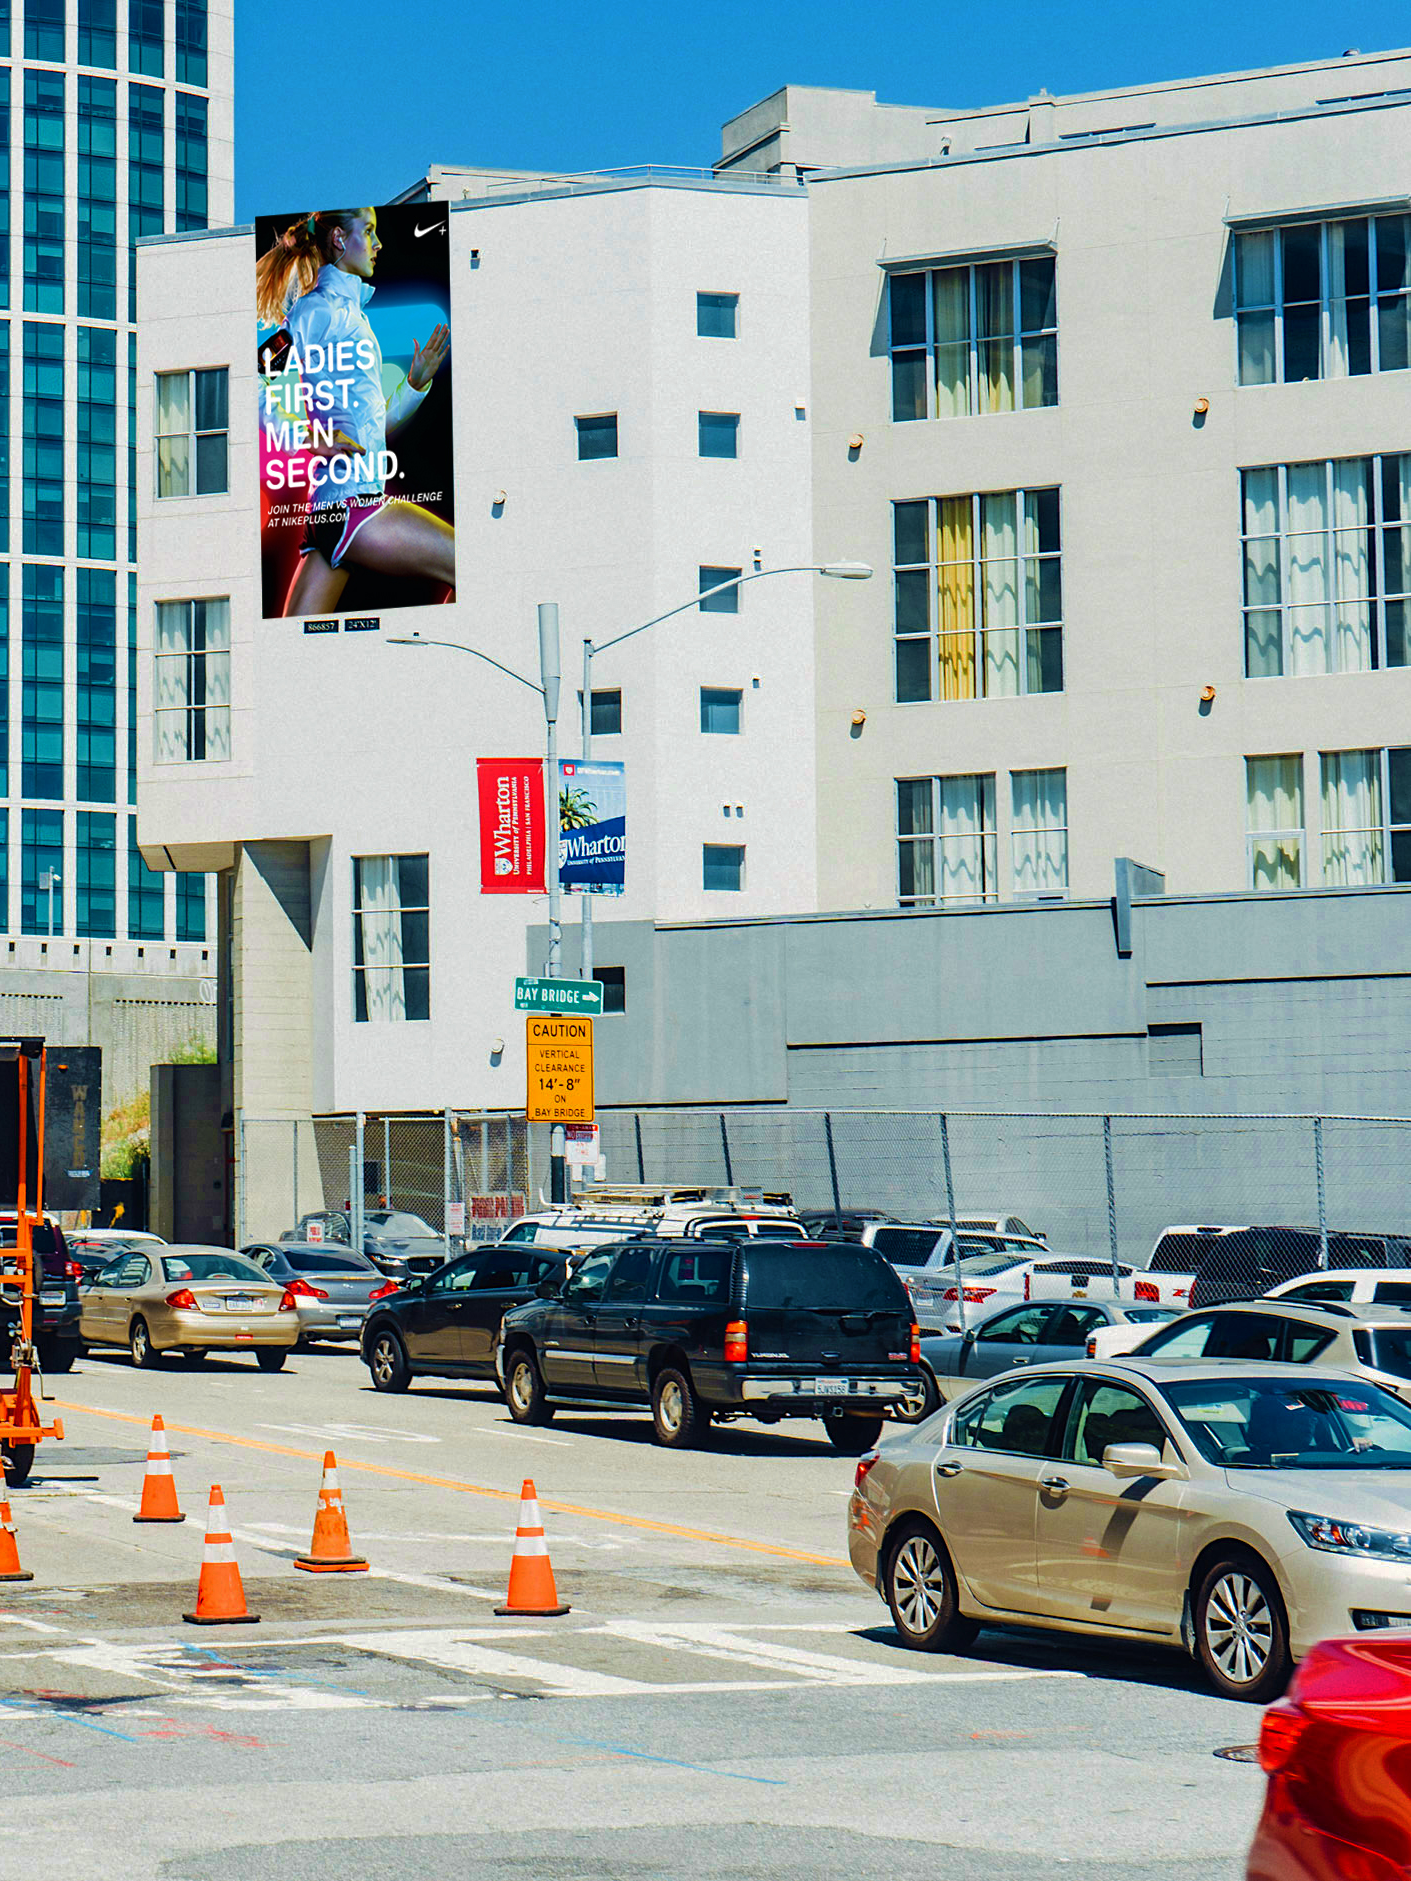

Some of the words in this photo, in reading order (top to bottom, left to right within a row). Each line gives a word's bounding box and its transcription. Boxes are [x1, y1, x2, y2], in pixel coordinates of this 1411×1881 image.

[264, 339, 375, 379] LADIES
[264, 378, 359, 416] FIRST.
[265, 417, 334, 453] MEN
[265, 450, 405, 490] SECOND.
[268, 504, 290, 516] JOIN
[293, 502, 311, 514] THE
[313, 500, 334, 512] MEN
[335, 499, 348, 510] VS
[350, 496, 386, 509] WOMEN
[388, 491, 443, 506] CHALLENGE
[267, 517, 280, 528] AT
[281, 511, 350, 527] NIKEPLUS.COM
[493, 776, 512, 857] Wharton
[517, 986, 539, 1001] BAY
[541, 988, 580, 1004] BRIDGE
[533, 1024, 586, 1038] CAUTION
[540, 1050, 580, 1059] VERTICAL
[535, 1064, 585, 1073] CLEARANCE
[554, 1095, 566, 1104] ON
[535, 1108, 551, 1117] BAY
[554, 1108, 585, 1118] BRIDGE
